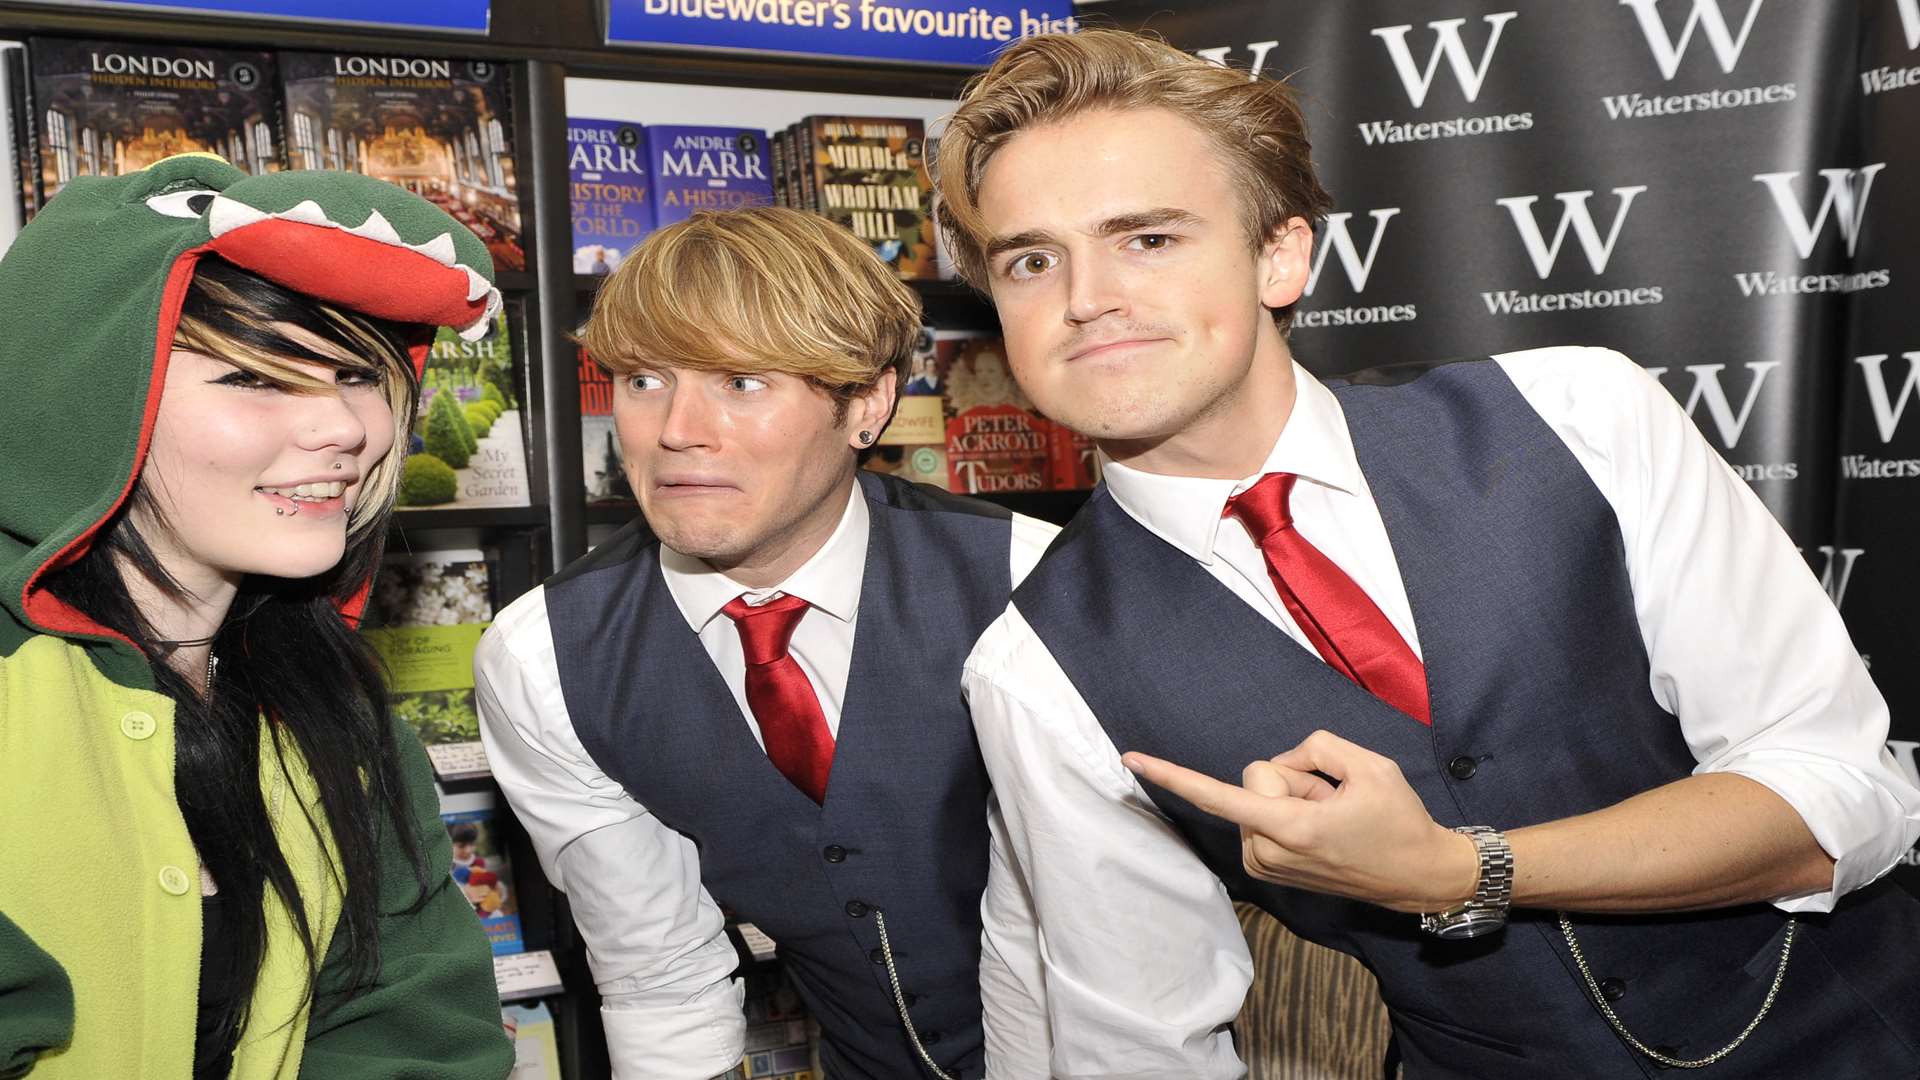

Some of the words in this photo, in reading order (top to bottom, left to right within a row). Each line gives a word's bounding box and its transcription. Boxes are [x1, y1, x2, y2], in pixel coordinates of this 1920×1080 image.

[644, 0, 851, 30] Bluewater's
[859, 0, 1013, 41] favourite
[1618, 0, 1764, 81] W
[91, 52, 215, 79] LONDON
[334, 56, 450, 79] LONDON
[1370, 11, 1519, 109] W
[1602, 83, 1797, 120] Waterstones
[1358, 112, 1534, 146] Waterstones
[662, 150, 768, 180] MARR
[592, 202, 623, 218] THE
[663, 189, 680, 208] A
[824, 184, 920, 210] WROTHAM
[1752, 162, 1887, 260] W
[571, 216, 640, 238] ORLD
[852, 211, 899, 240] HILL
[1495, 185, 1648, 280] W
[1480, 286, 1664, 316] Waterstones
[964, 414, 1031, 433] PETER
[949, 432, 1048, 453] ACKROYD
[482, 449, 509, 467] My
[471, 466, 516, 482] Secret
[465, 482, 519, 499] Garden
